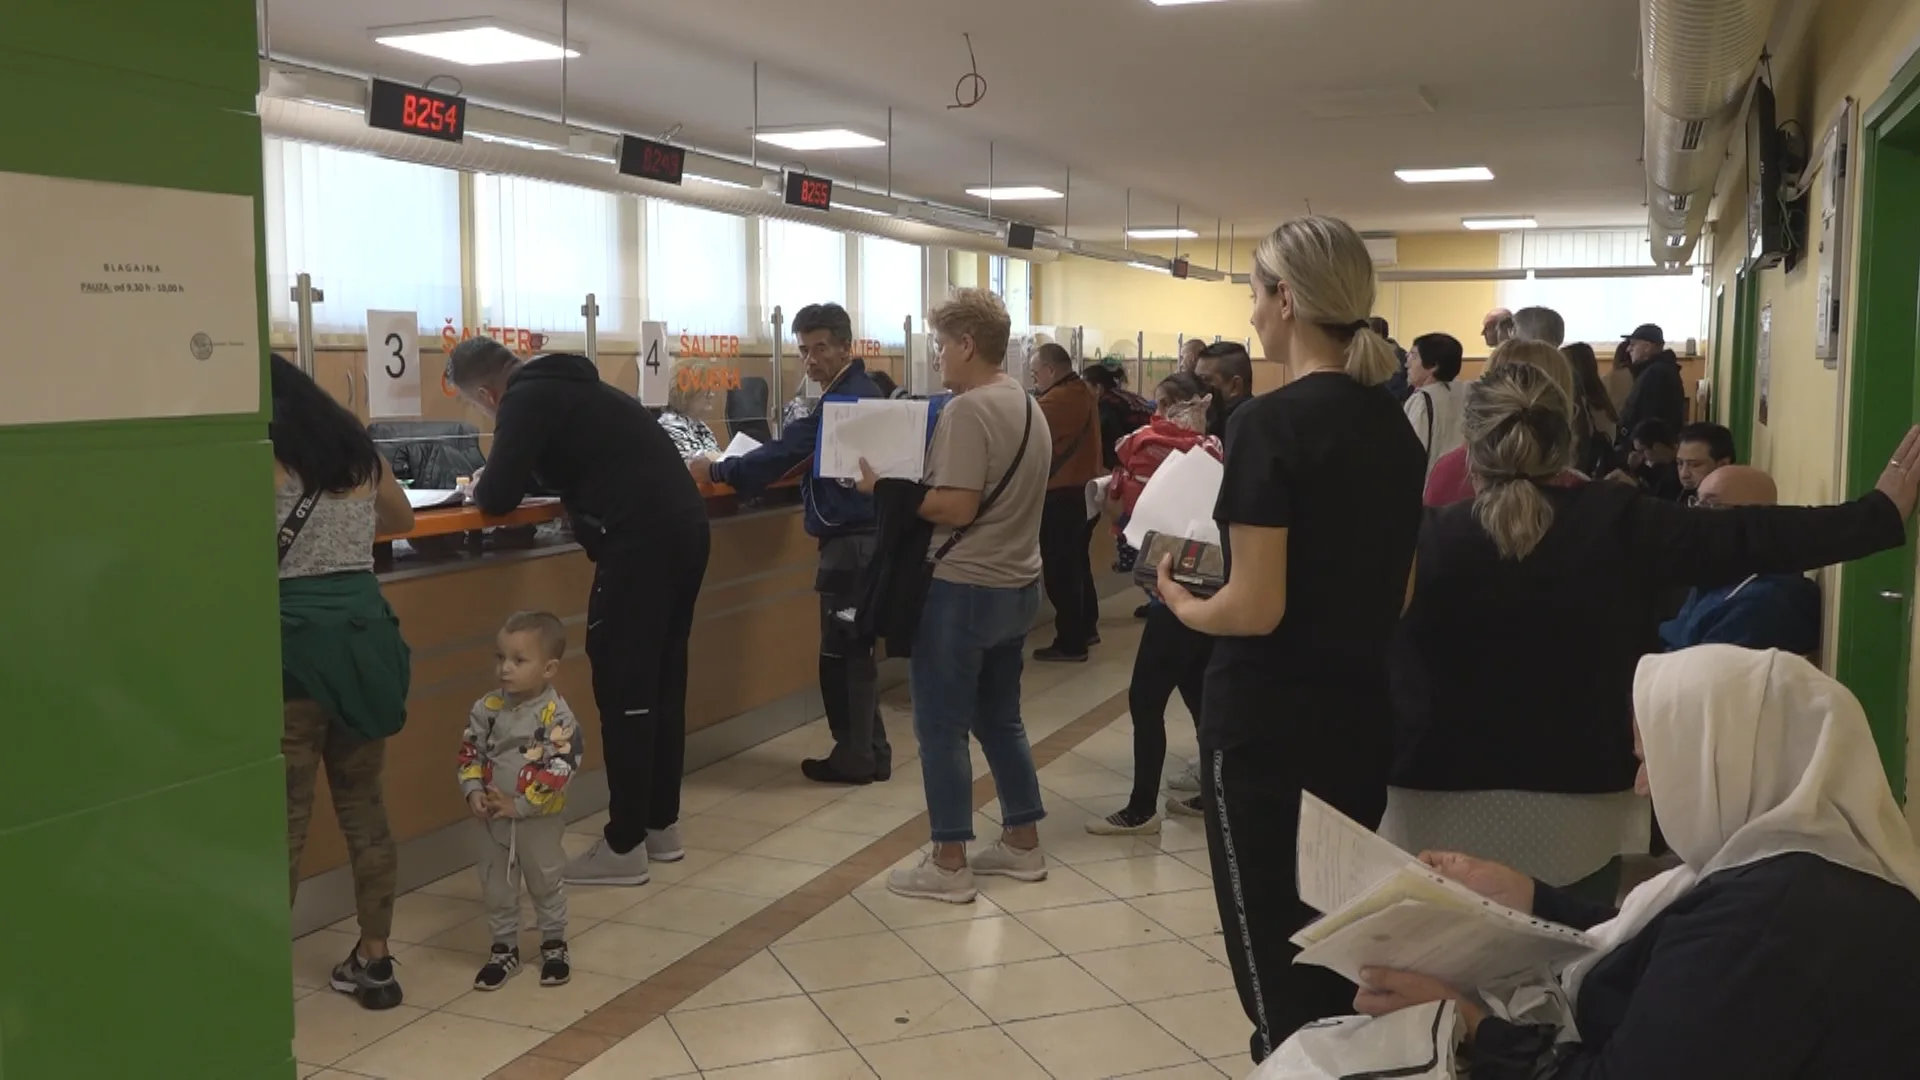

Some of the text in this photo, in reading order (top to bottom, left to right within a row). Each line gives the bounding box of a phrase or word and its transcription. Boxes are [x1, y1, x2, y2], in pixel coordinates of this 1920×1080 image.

[403, 94, 457, 133] B254
[802, 180, 828, 205] B255
[385, 333, 406, 378] 3
[646, 339, 660, 376] 4
[680, 328, 740, 358] ŠALTER
